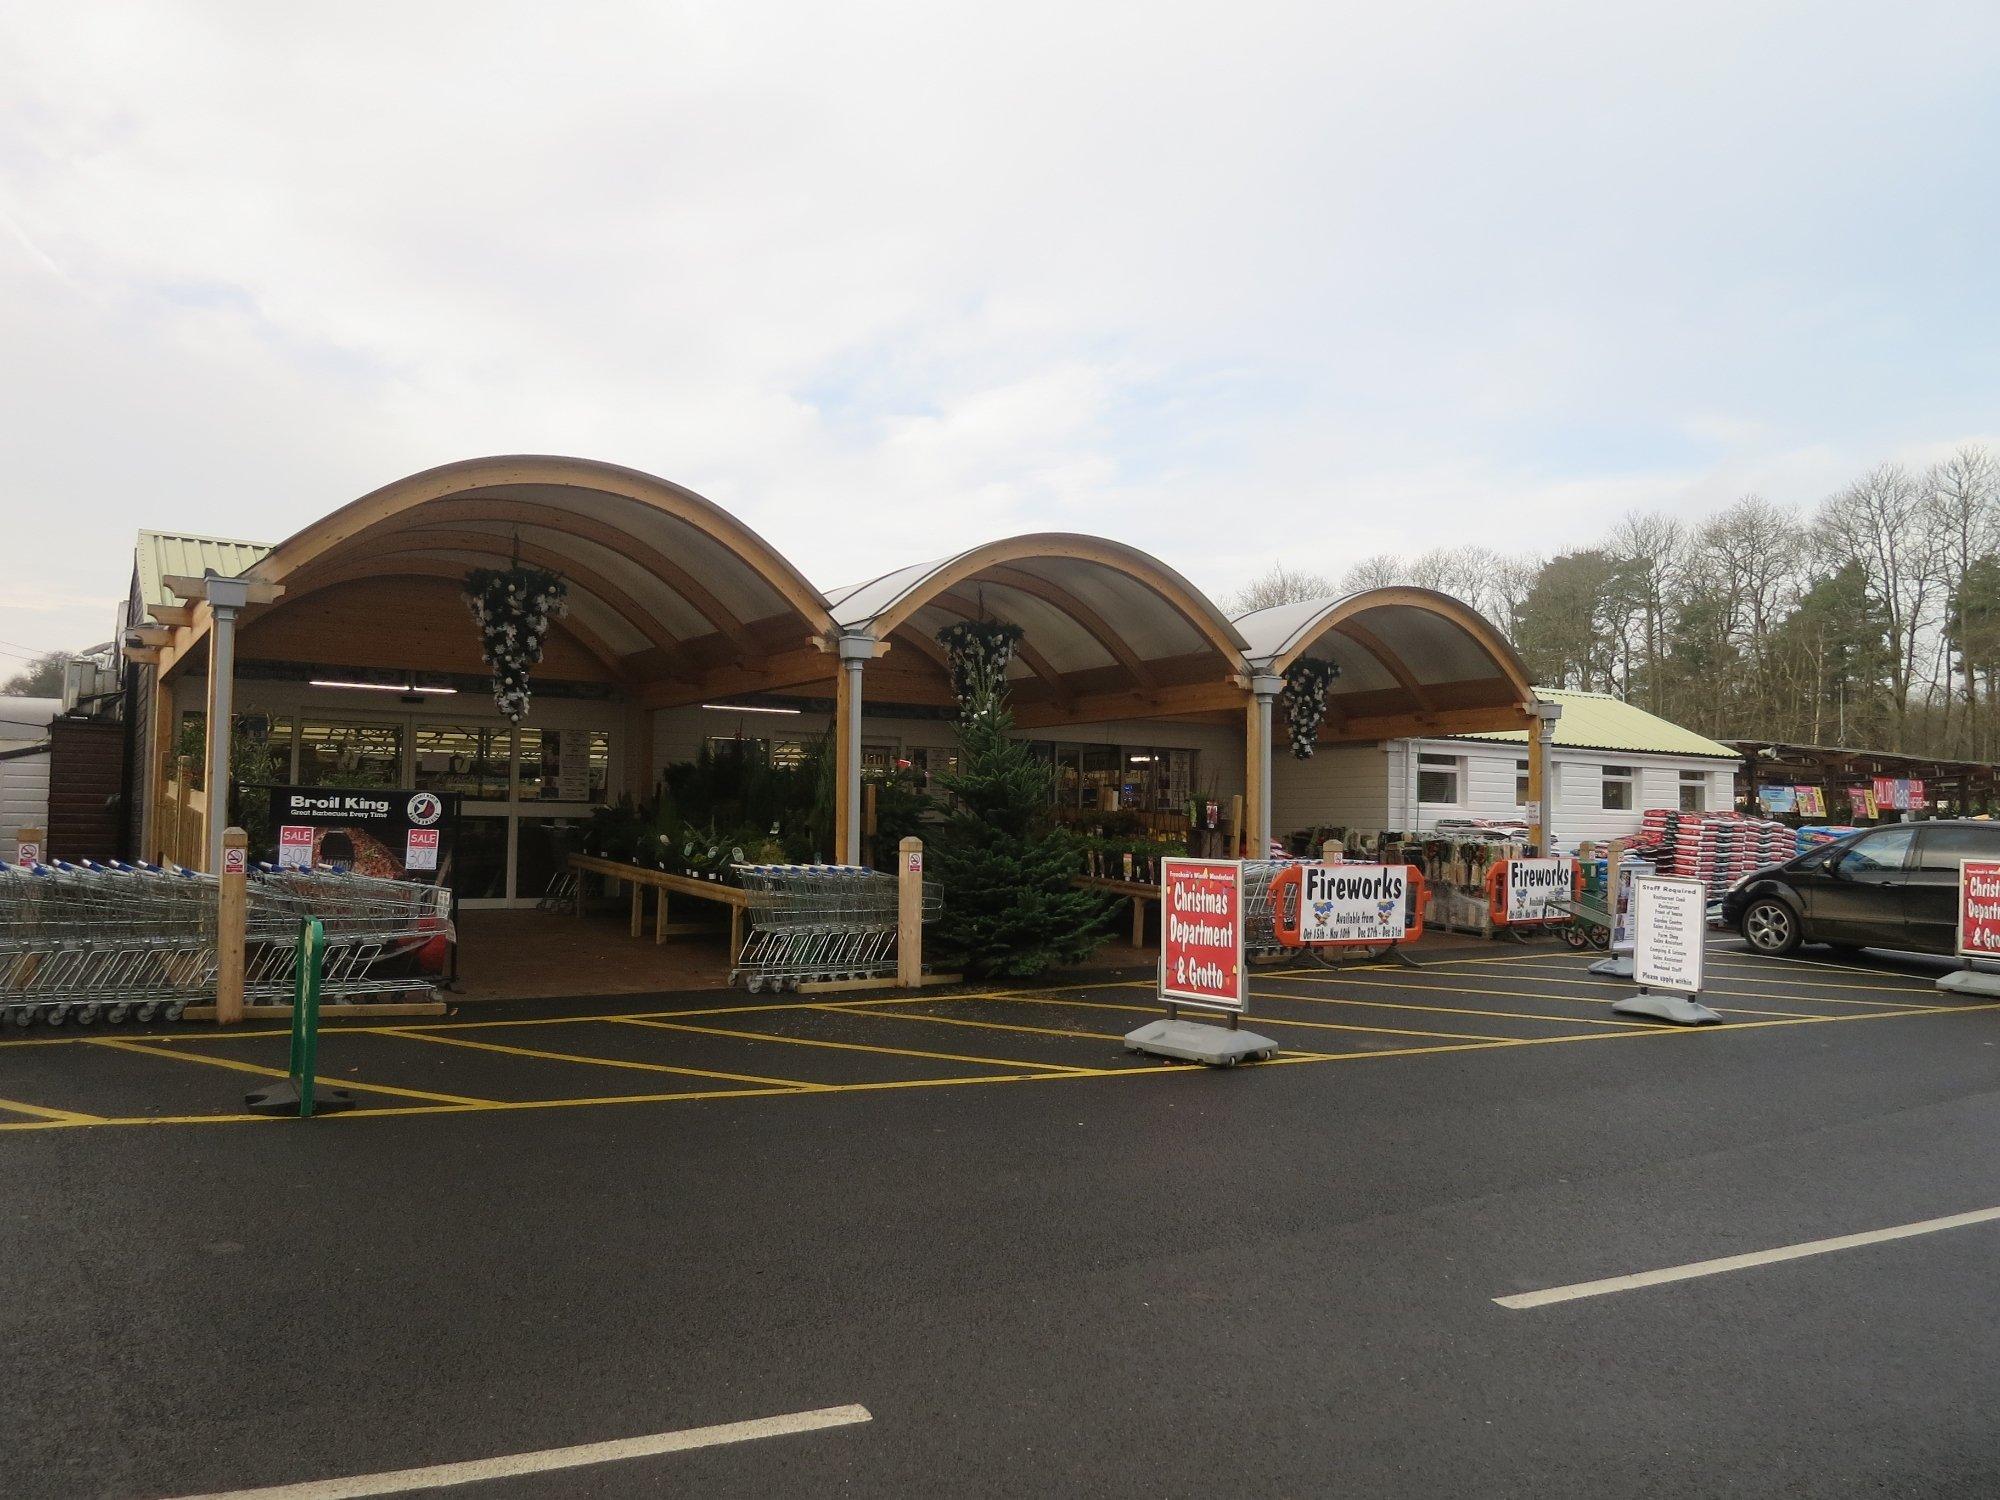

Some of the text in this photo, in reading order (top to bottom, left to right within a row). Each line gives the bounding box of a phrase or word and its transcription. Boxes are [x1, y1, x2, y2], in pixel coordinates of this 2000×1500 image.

[290, 796, 389, 812] Broil King
[349, 811, 369, 819] Every
[283, 831, 310, 841] SALE
[411, 833, 436, 844] SALE
[1512, 860, 1568, 888] Fireworks
[1307, 867, 1402, 900] Fireworks
[1663, 886, 1696, 895] Required
[1174, 881, 1228, 915] Christmas
[1336, 911, 1374, 924] Available from
[1968, 898, 2000, 925] Depart
[1170, 913, 1233, 952] Department
[1973, 926, 1981, 946] &
[1177, 956, 1223, 989] & Grotto
[1642, 971, 1658, 980] Please
[1660, 976, 1673, 984] apply
